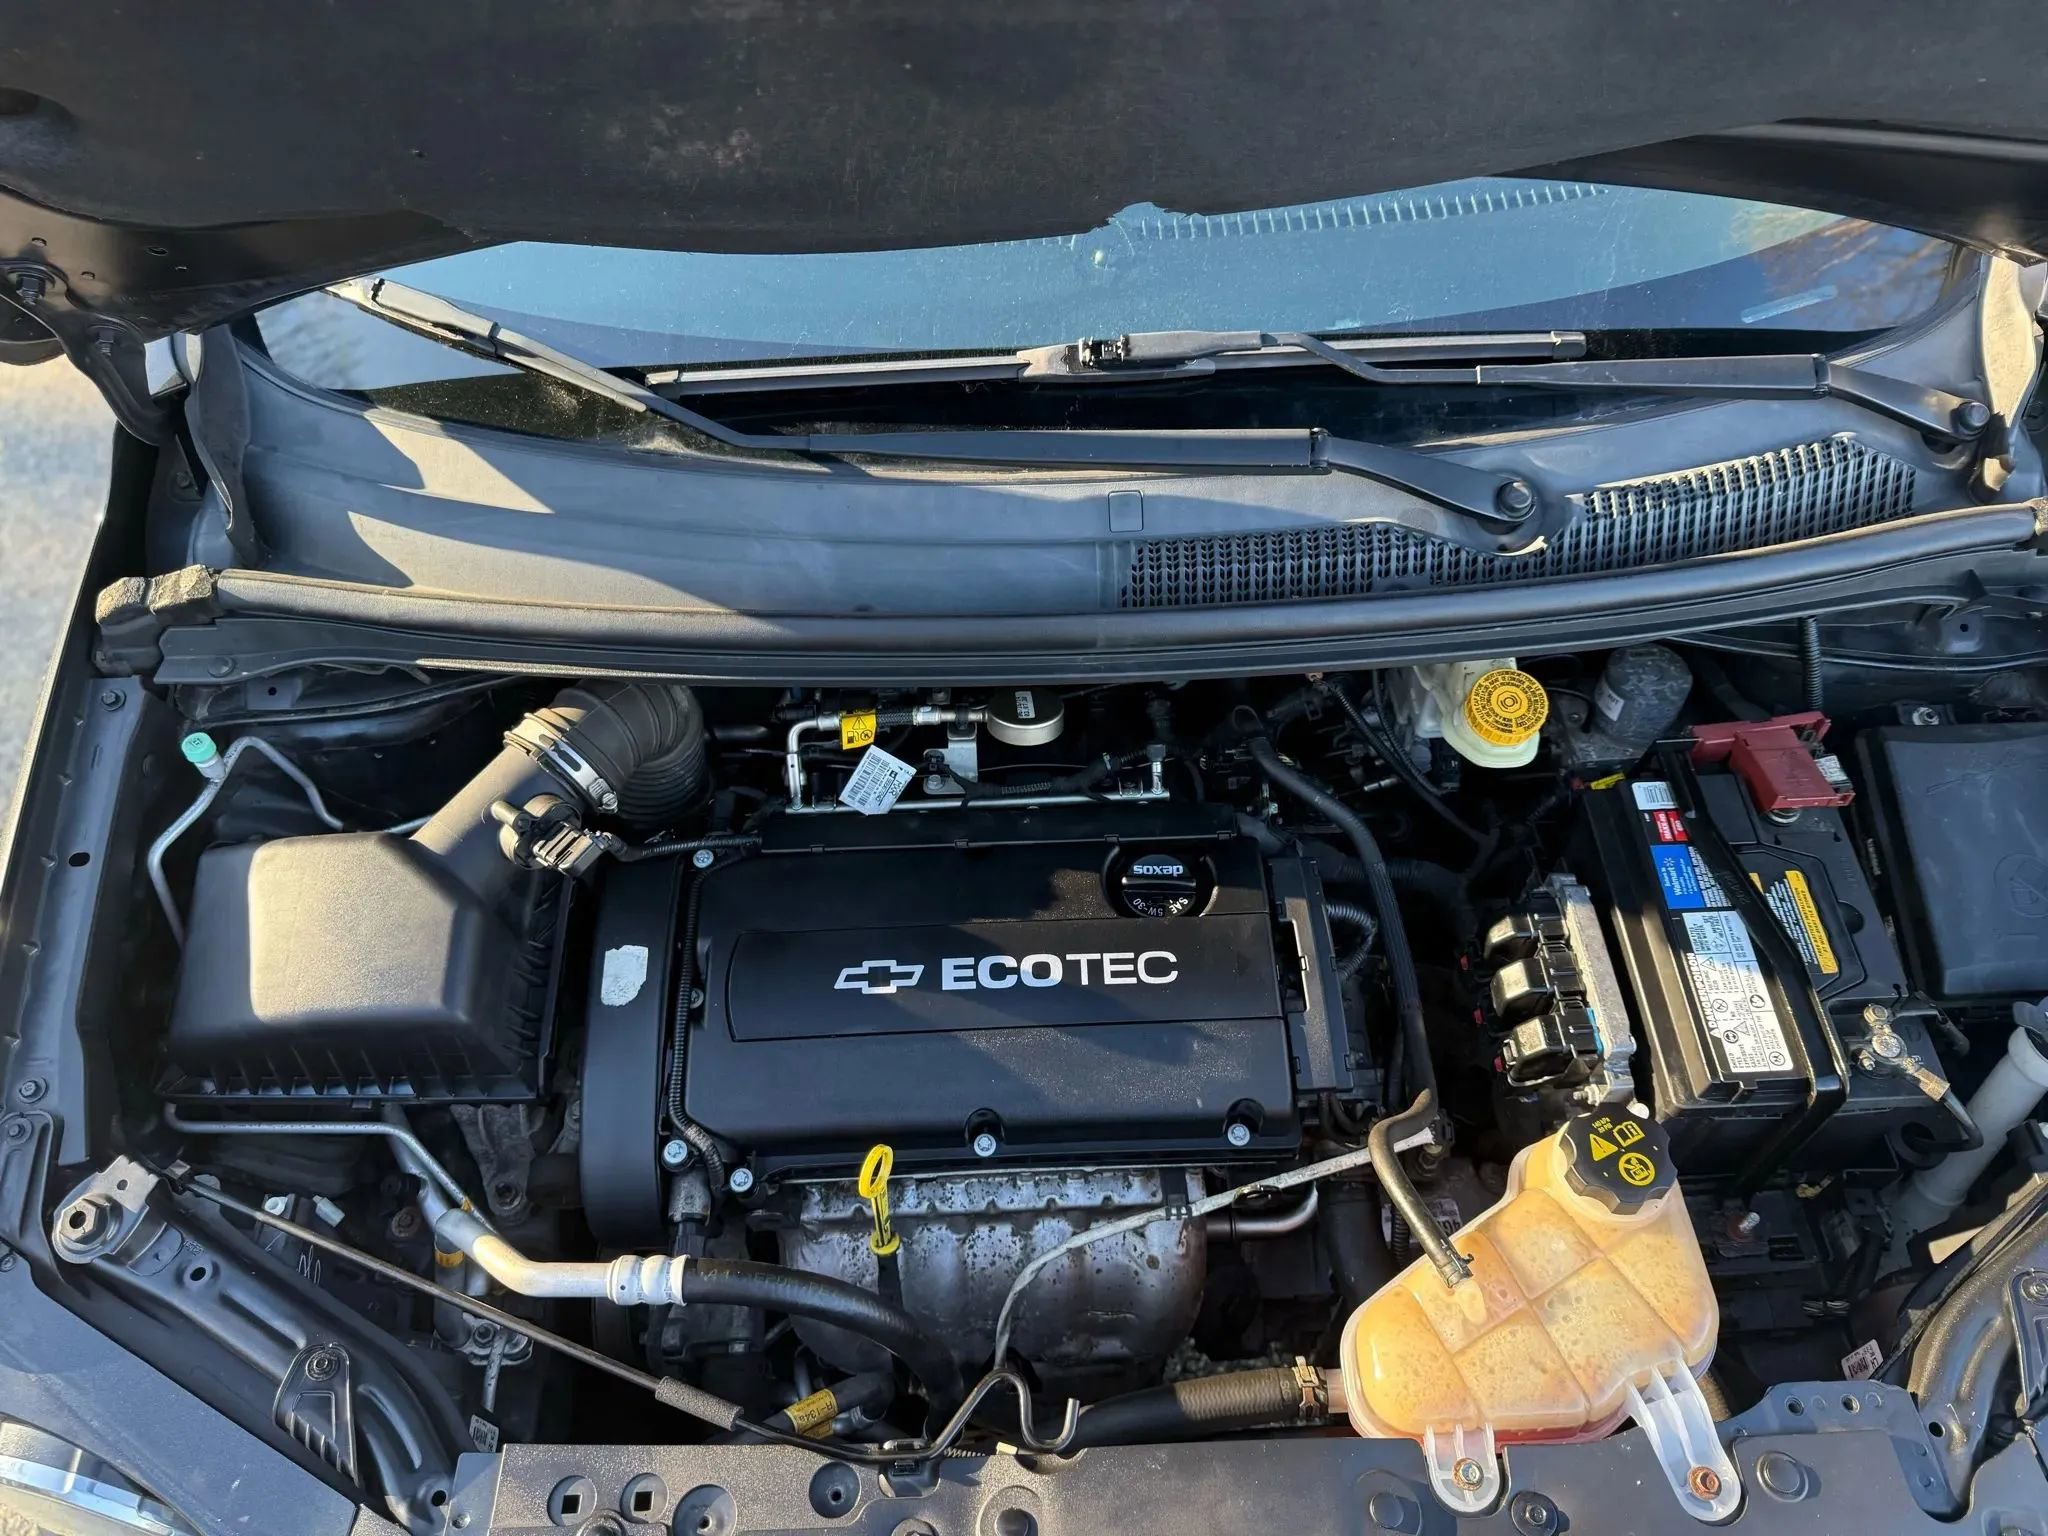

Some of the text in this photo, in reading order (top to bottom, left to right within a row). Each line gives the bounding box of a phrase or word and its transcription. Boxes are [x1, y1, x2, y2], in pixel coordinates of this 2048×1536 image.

[1133, 865, 1184, 877] dexos
[1667, 866, 1683, 895] Walmart
[1133, 897, 1189, 917] SAE 5W-30
[942, 951, 1178, 990] ECOTEC
